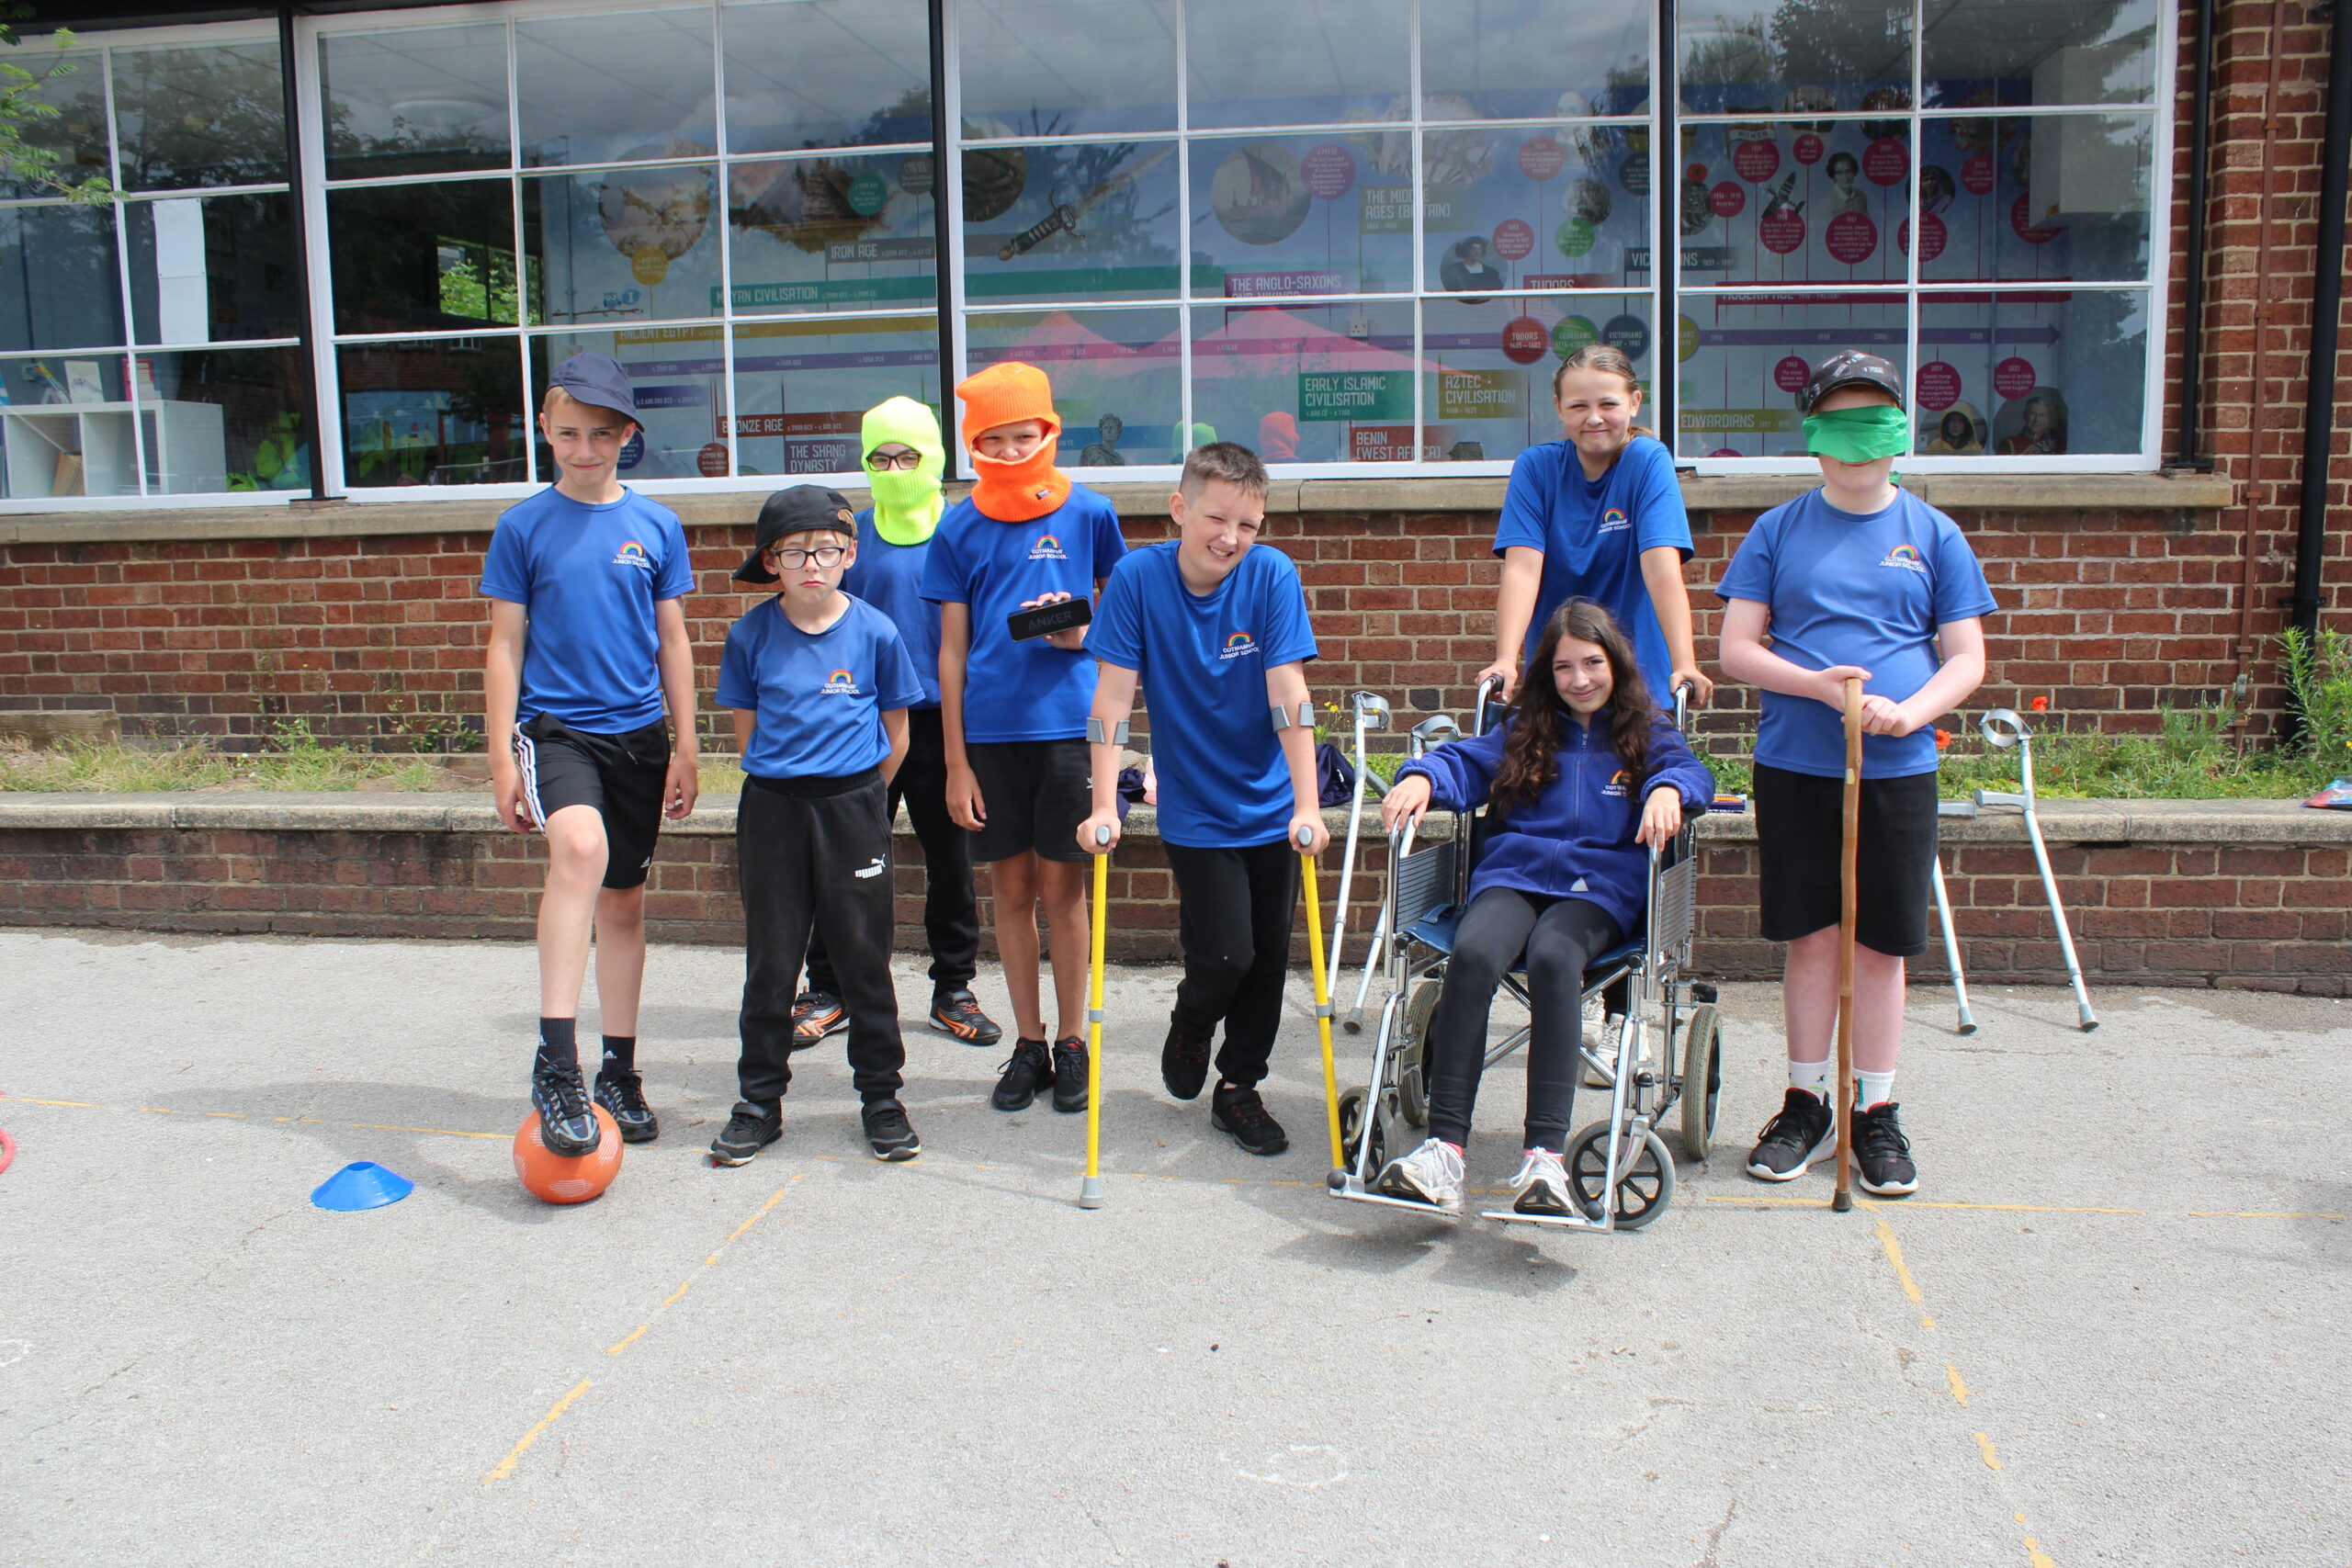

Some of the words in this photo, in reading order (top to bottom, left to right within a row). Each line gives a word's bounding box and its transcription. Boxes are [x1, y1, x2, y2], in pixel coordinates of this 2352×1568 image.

[1365, 190, 1386, 204] THE
[1390, 188, 1430, 204] MIDDE
[1365, 205, 1394, 220] AGES
[831, 244, 854, 259] IRON
[858, 243, 877, 257] AGE
[1231, 277, 1251, 291] THE
[1256, 275, 1342, 290] ANGLO-SAXONS
[716, 288, 752, 303] MYAN
[753, 287, 819, 302] CIVILISATION
[1609, 331, 1643, 340] VICTORIANS
[1306, 378, 1339, 392] EARLY
[1343, 377, 1386, 391] ISLAMIC
[1445, 375, 1481, 389] AZTEC
[1306, 392, 1374, 407] CIVILISATION
[1445, 389, 1516, 404] CIVILISATION
[722, 419, 761, 434] BONZE
[764, 418, 784, 432] AGE
[1680, 414, 1755, 428] EDWARDIANS
[1356, 432, 1387, 446] BENIN
[790, 445, 808, 458] THE
[812, 444, 845, 457] SHANG
[790, 457, 838, 472] DYNASTY
[1028, 610, 1073, 631] ANKER
[1219, 651, 1239, 660] JUNIOR
